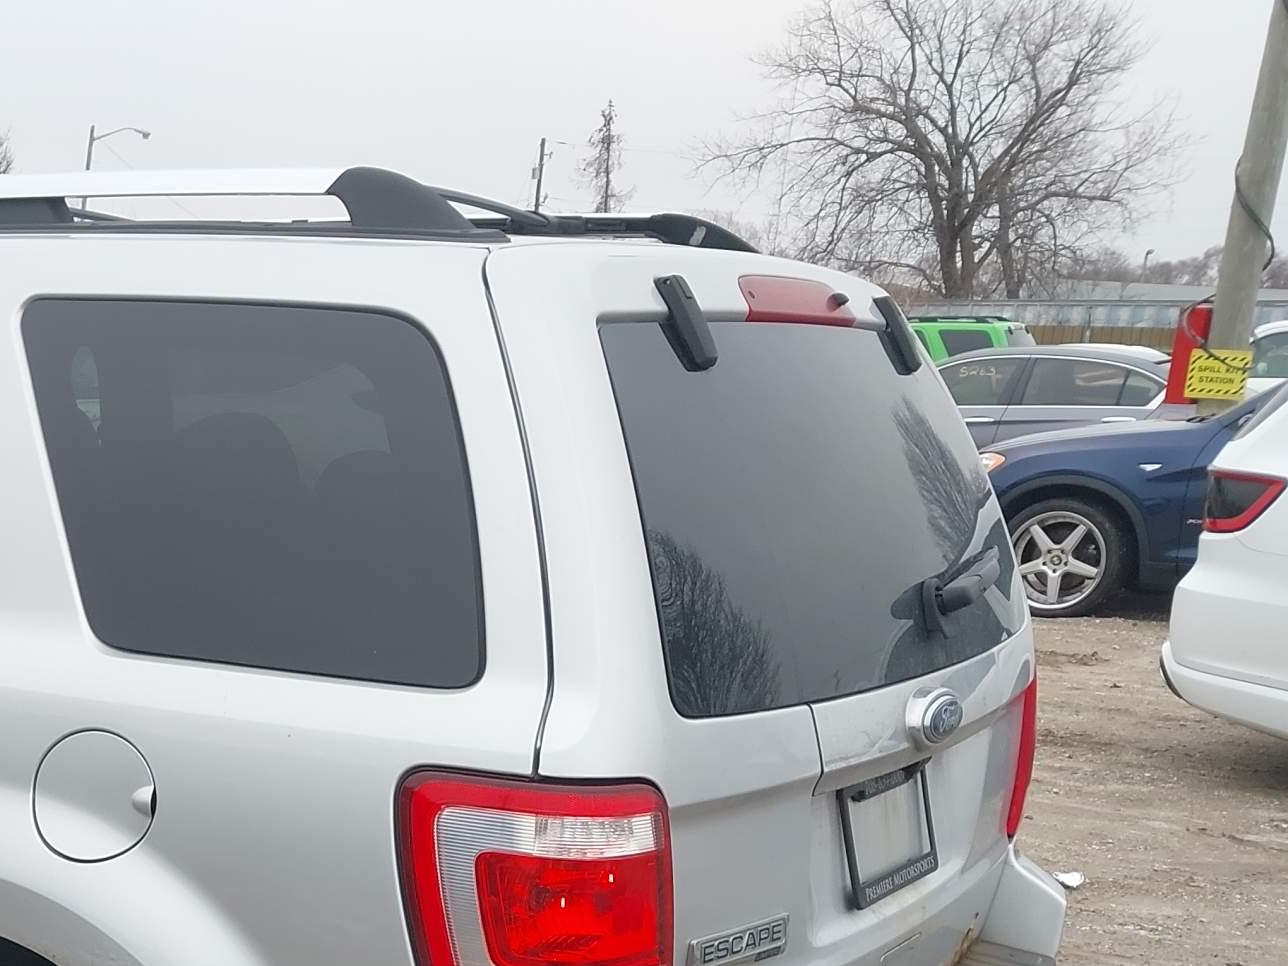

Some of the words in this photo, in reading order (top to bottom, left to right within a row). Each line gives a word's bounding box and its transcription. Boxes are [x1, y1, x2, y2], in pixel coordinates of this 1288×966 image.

[1197, 365, 1222, 373] SPILL
[1198, 376, 1235, 384] STATION
[702, 921, 784, 965] ESCAPE
